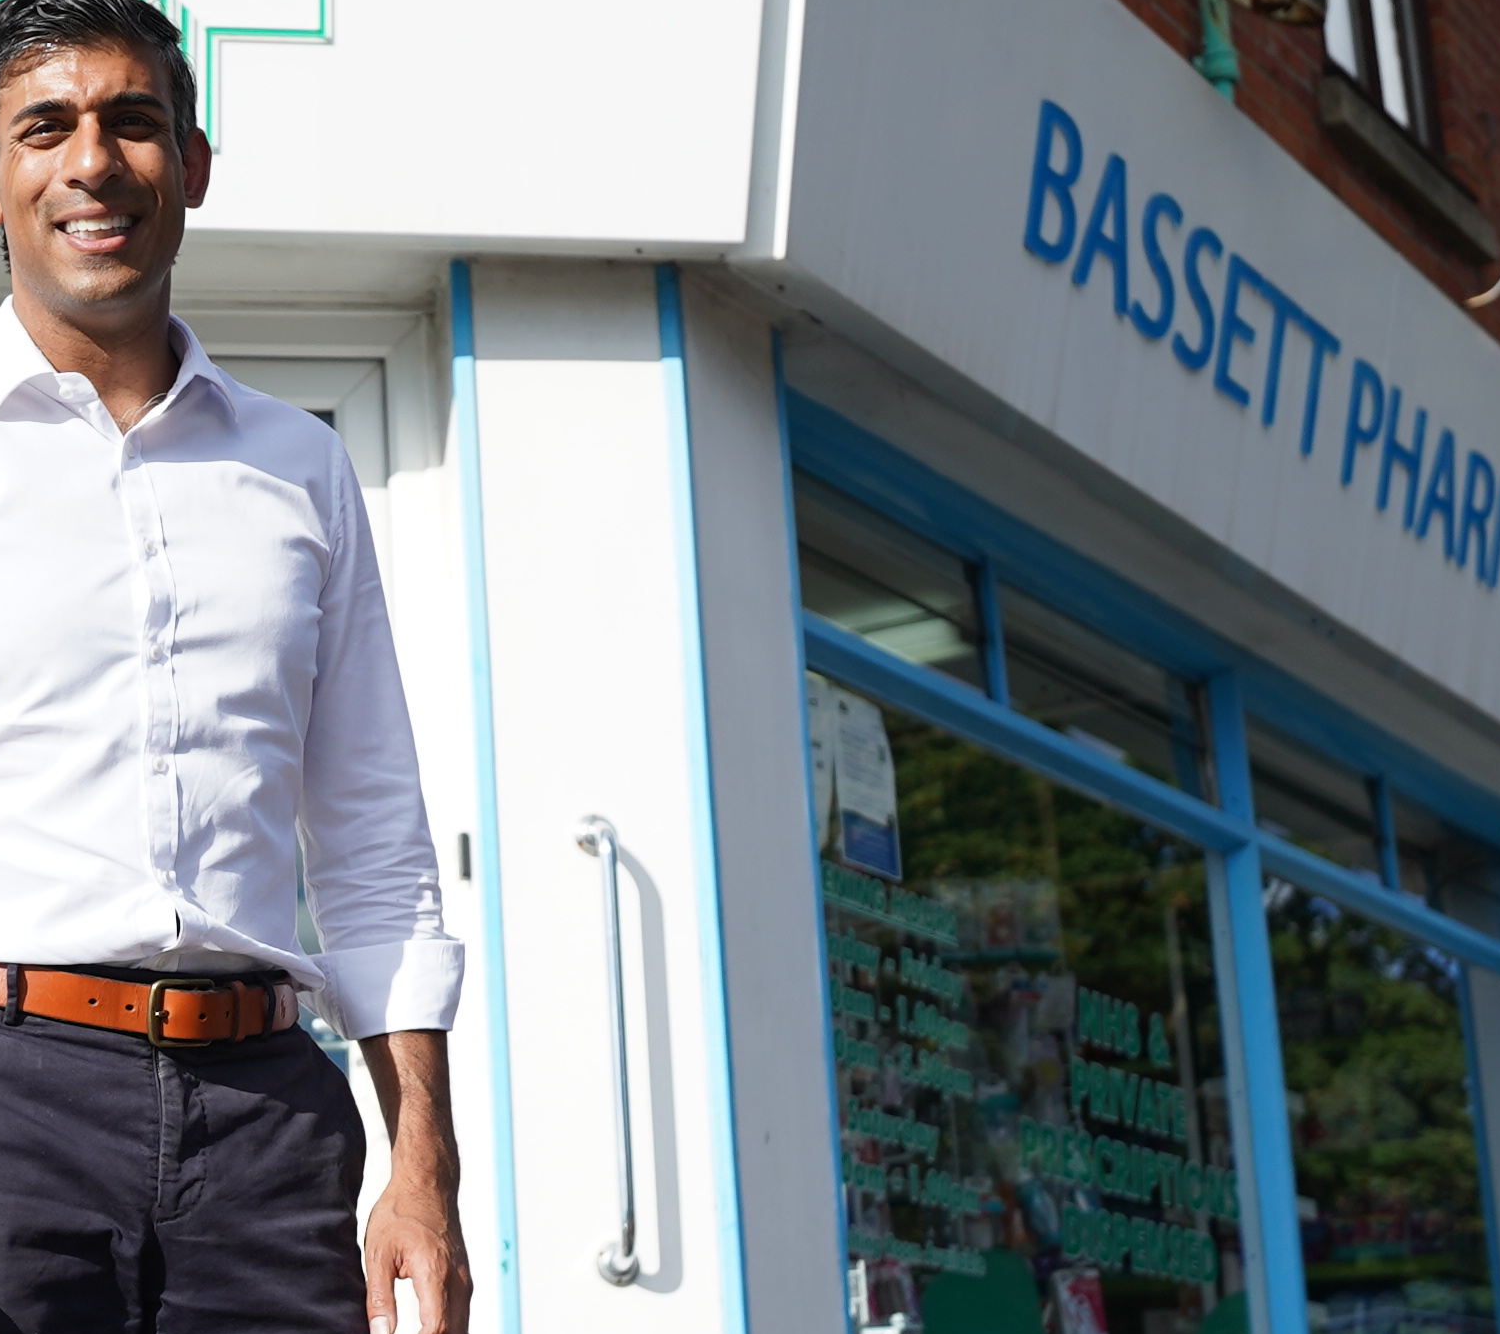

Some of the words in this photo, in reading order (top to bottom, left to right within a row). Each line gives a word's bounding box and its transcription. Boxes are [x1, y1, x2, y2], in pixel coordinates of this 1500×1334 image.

[1023, 99, 1341, 458] BASSETT
[1078, 985, 1141, 1062] NHS
[1148, 1011, 1171, 1071] &
[1069, 1054, 1187, 1144] PRIVATE
[1018, 1114, 1239, 1225] PRESCRIPTIONS
[1061, 1200, 1219, 1287] DISPENSED
